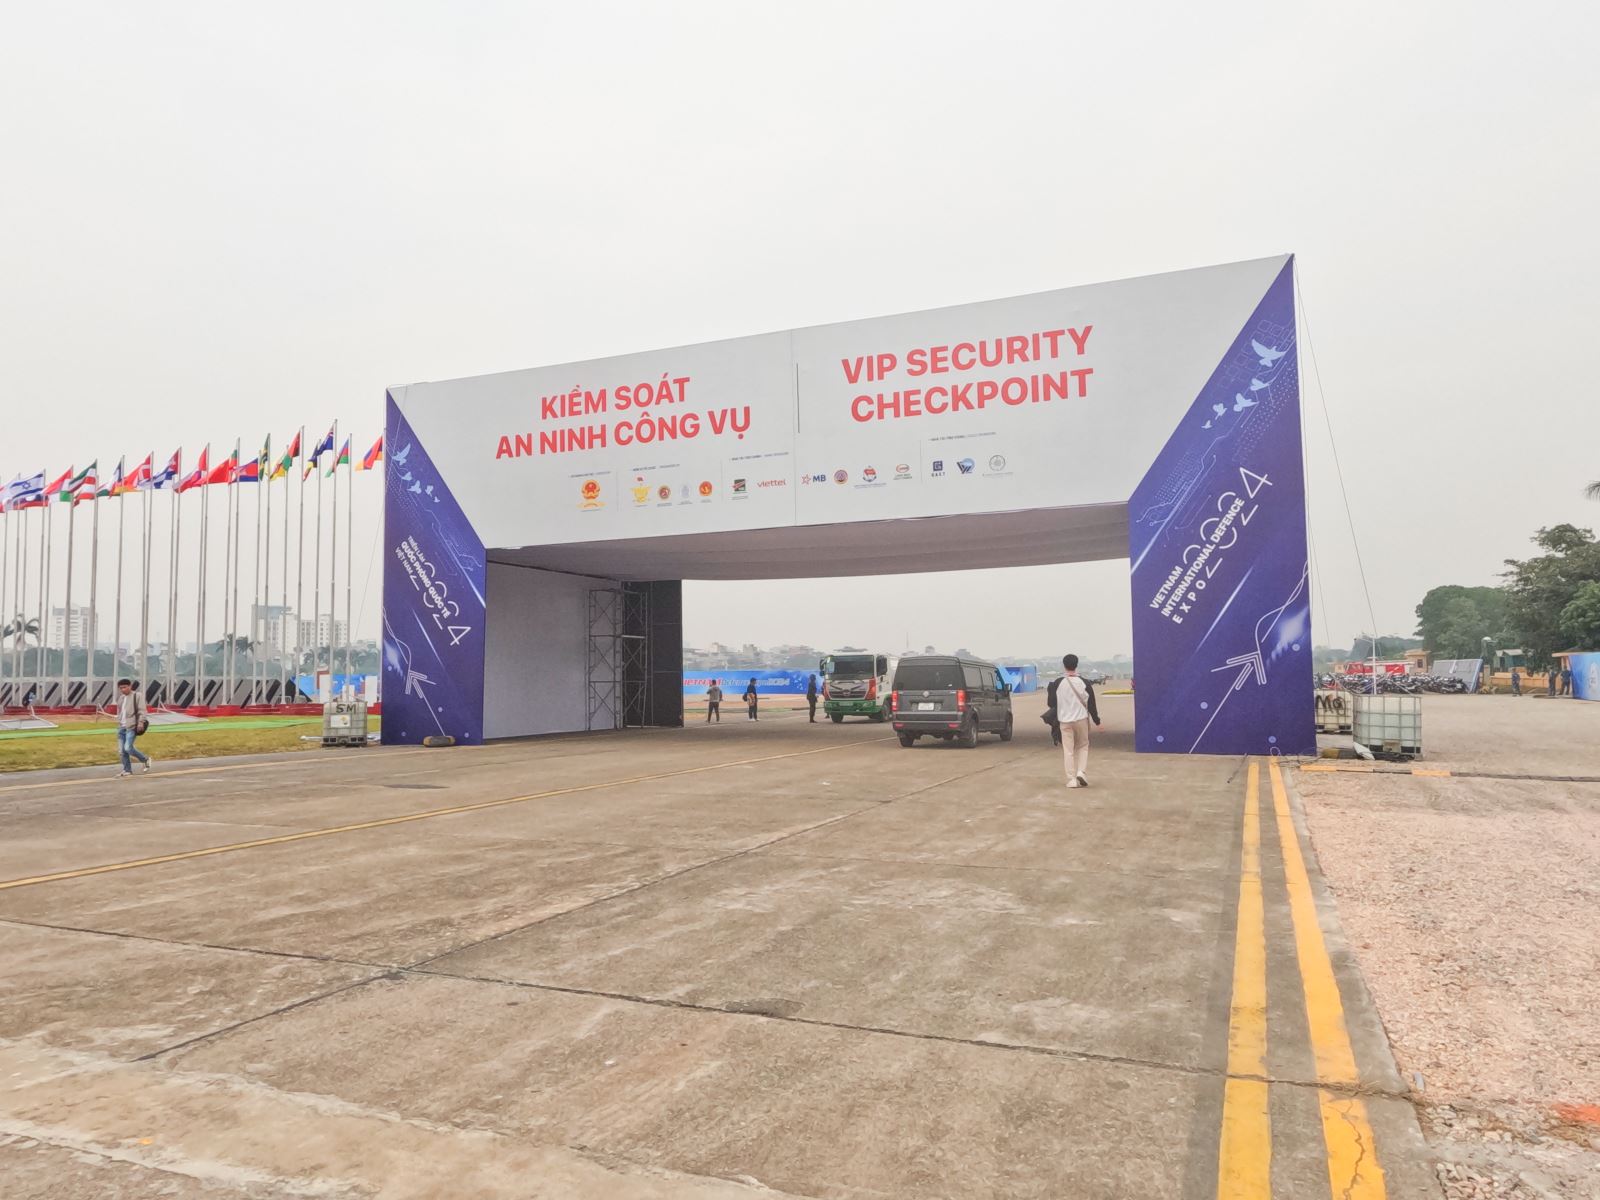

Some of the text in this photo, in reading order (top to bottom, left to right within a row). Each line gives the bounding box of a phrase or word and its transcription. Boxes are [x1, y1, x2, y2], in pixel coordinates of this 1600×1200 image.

[841, 325, 1093, 385] VIP SECURITY
[541, 372, 690, 420] KIỂM SOÁT
[851, 368, 1094, 423] CHECKPOINT
[496, 406, 751, 460] AN NINH CÔNG VỤ
[812, 474, 827, 483] MB
[1161, 498, 1245, 617] INTERNATIONAL DEFENCE
[1150, 566, 1184, 609] VIETNAM
